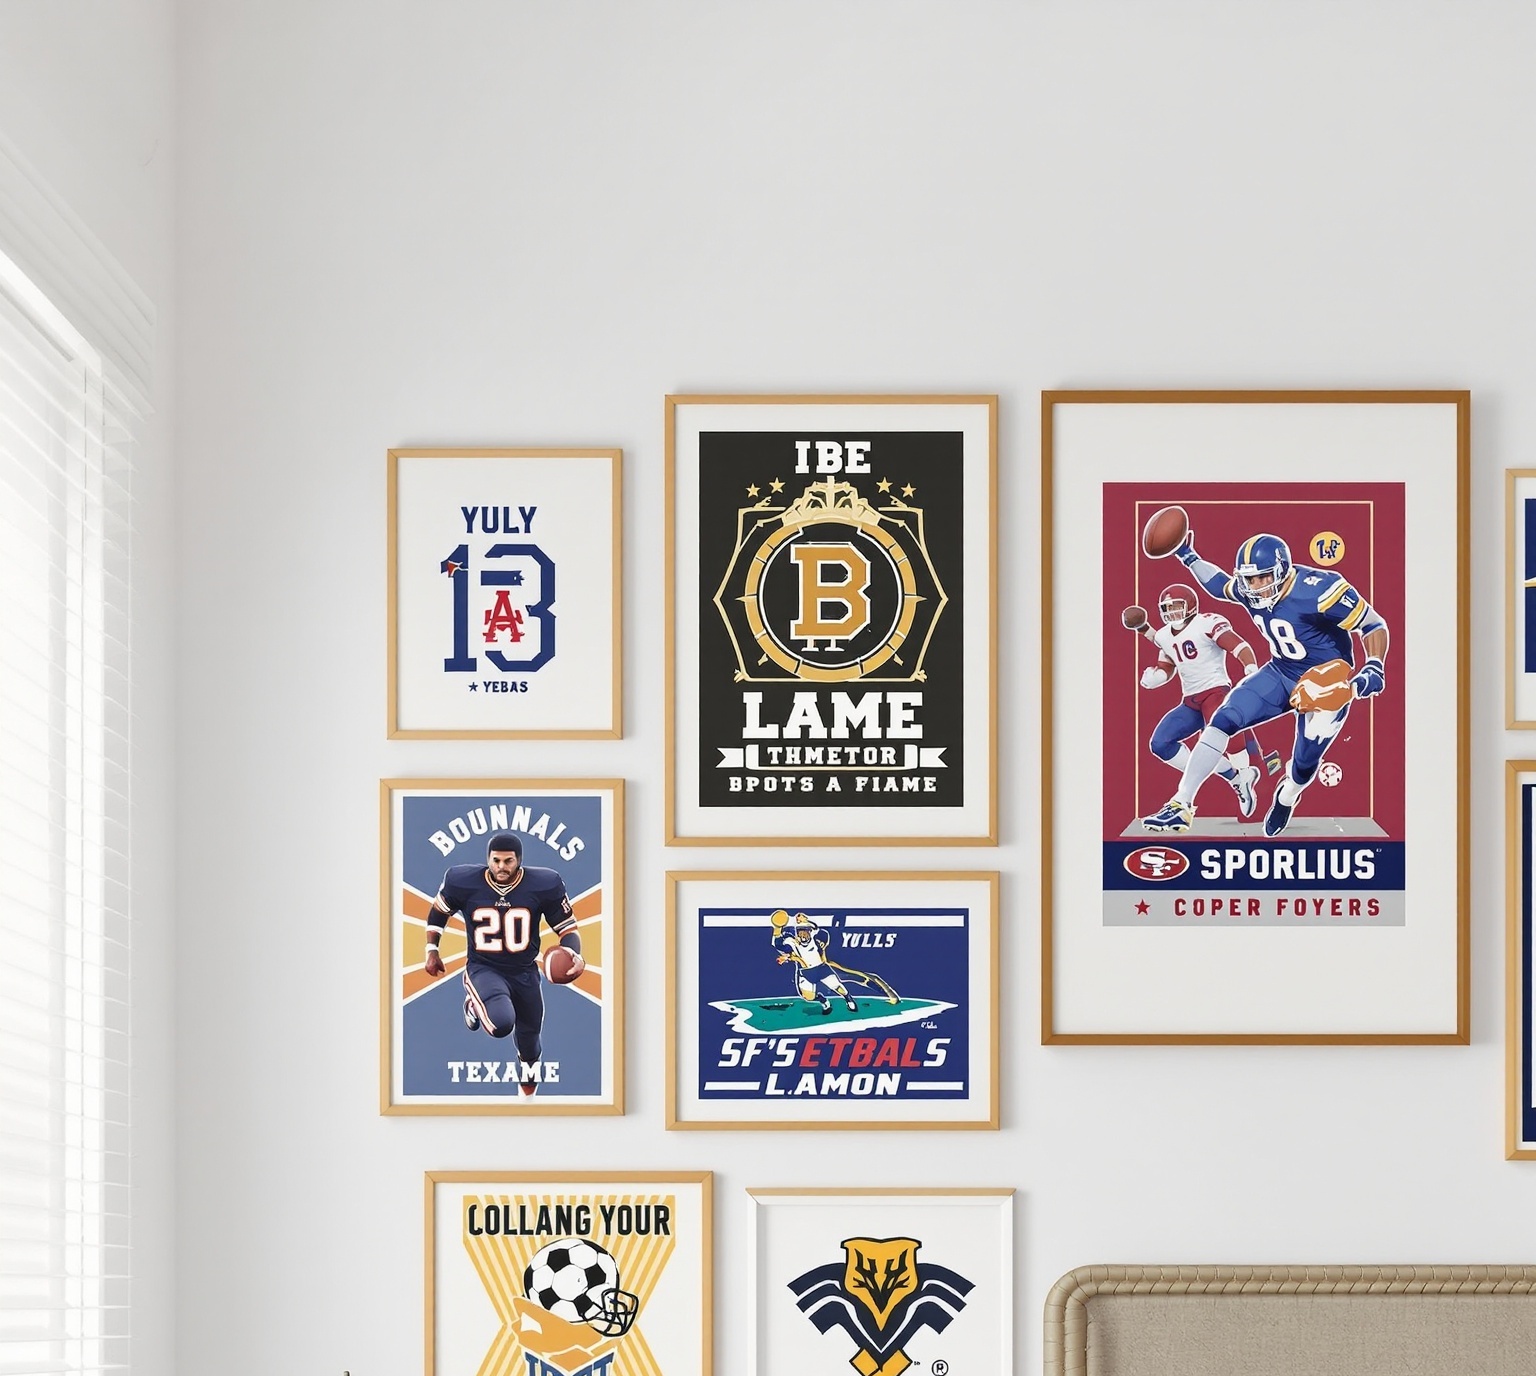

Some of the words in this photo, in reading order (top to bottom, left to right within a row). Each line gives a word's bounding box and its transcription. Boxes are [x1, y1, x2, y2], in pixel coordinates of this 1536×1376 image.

[795, 441, 871, 474] IBE
[461, 506, 537, 534] YULY
[483, 681, 529, 693] YEBAS
[742, 691, 924, 740] LAME
[767, 747, 897, 765] THMETOR
[825, 776, 842, 792] A
[428, 803, 586, 862] BOUNNALS
[1200, 848, 1376, 880] SPORLIUS
[1174, 898, 1261, 917] COPER
[1276, 898, 1381, 917] FOYERS
[472, 907, 531, 953] 20
[447, 1060, 560, 1084] TEXAME
[468, 1205, 591, 1236] COLLANG
[600, 1205, 671, 1236] YOUR
